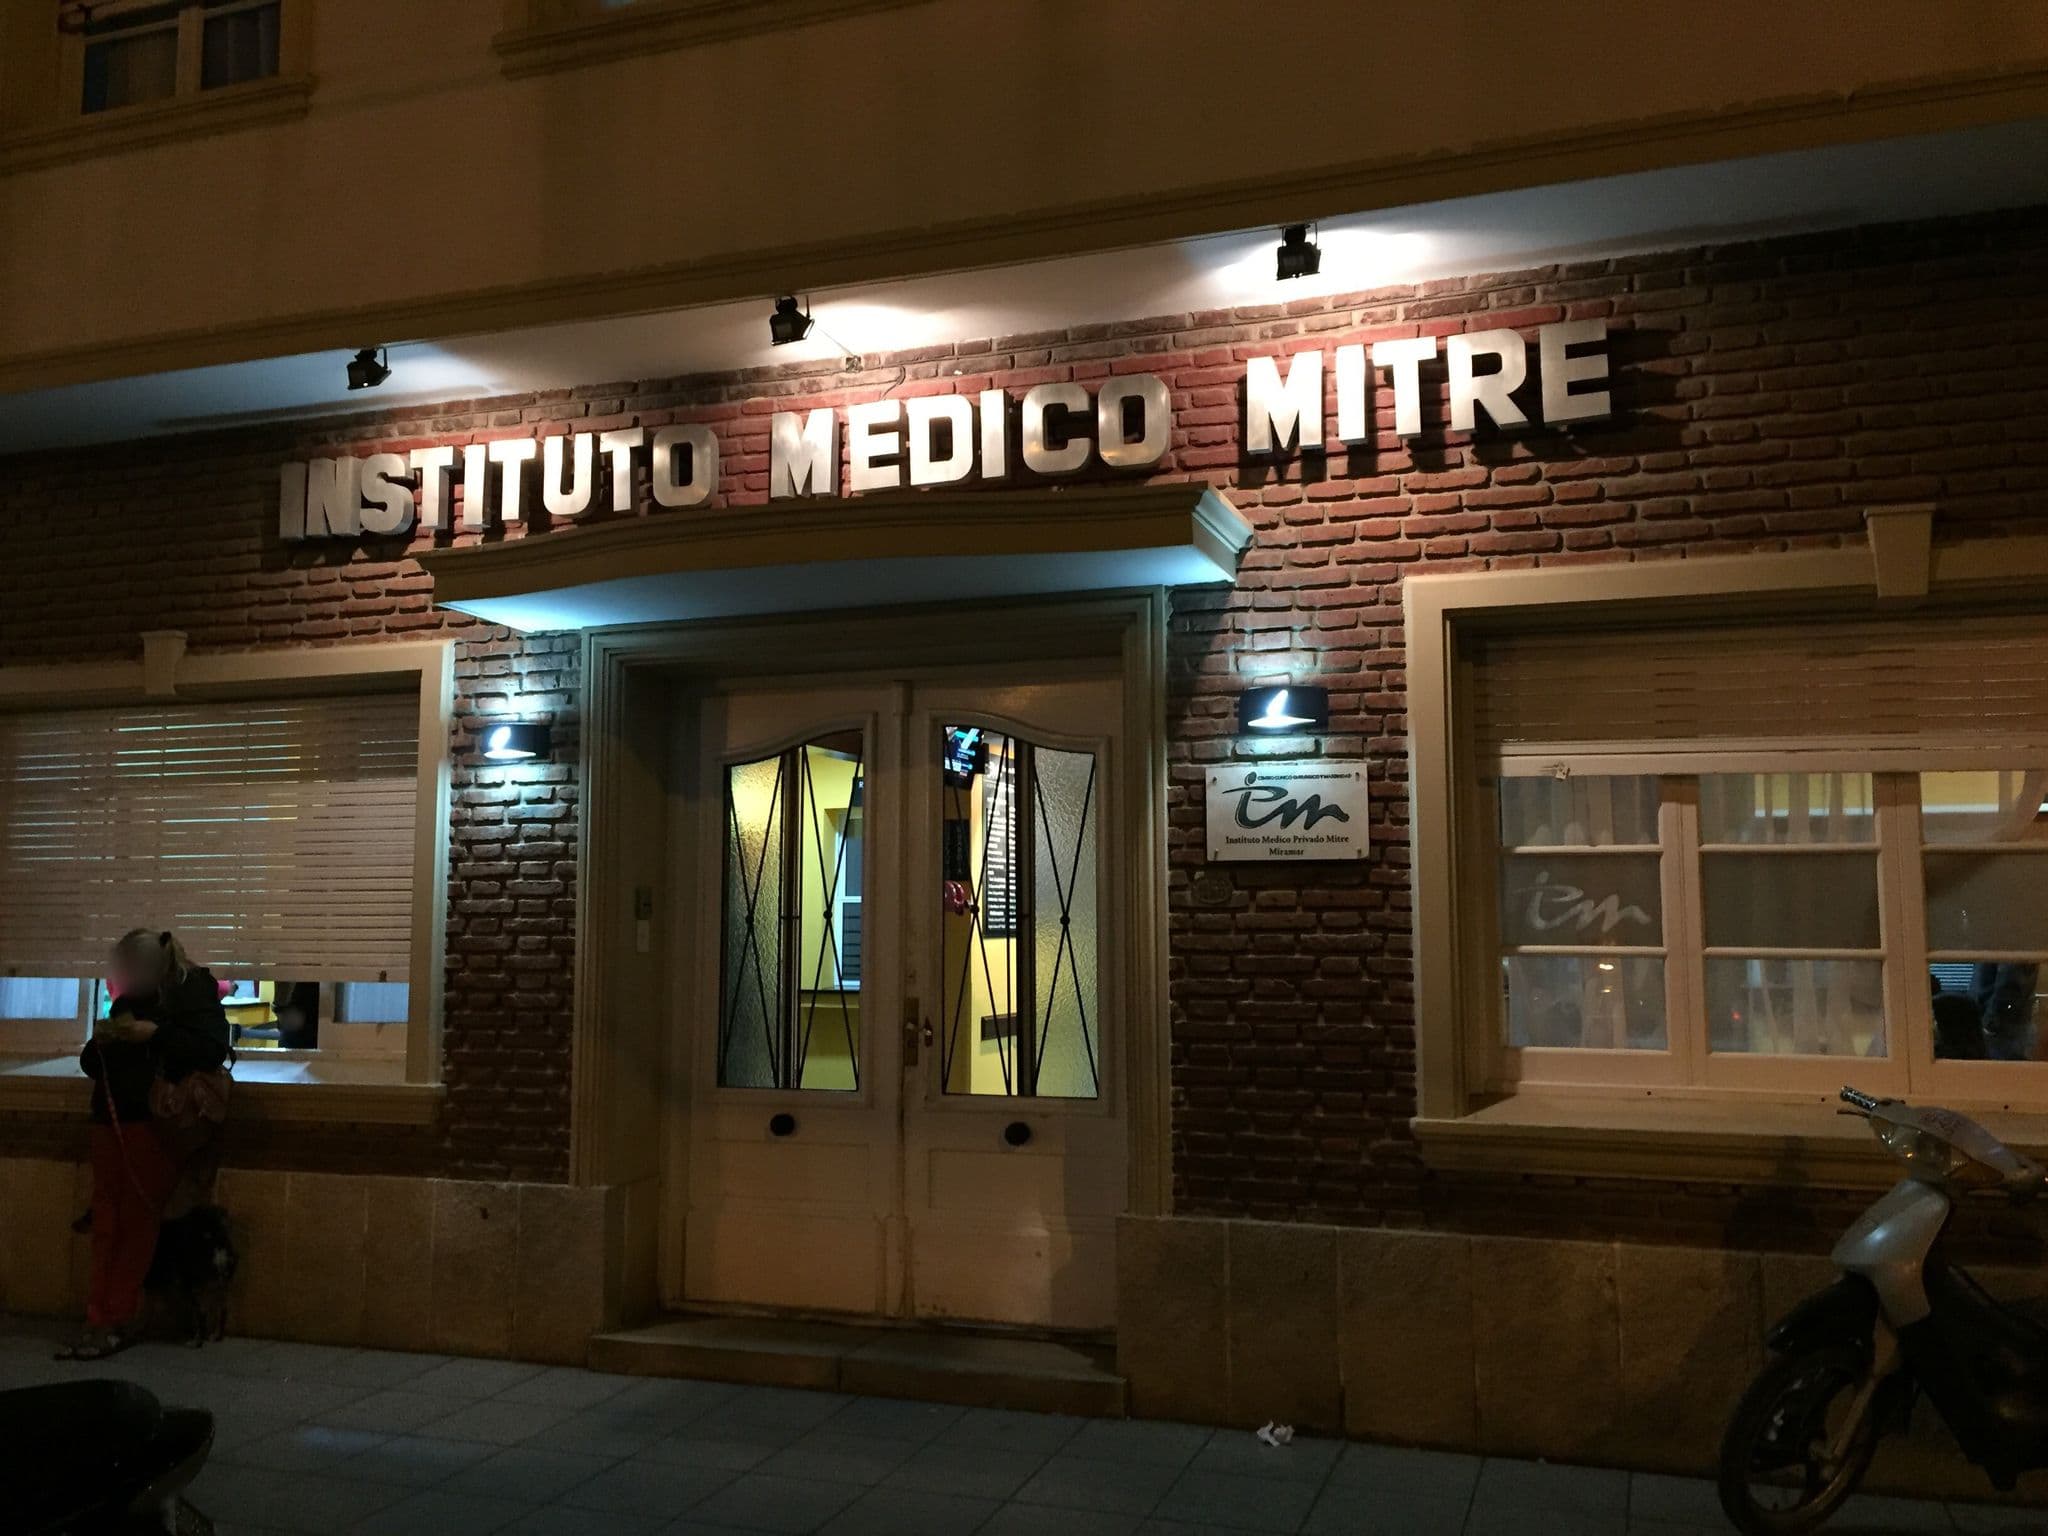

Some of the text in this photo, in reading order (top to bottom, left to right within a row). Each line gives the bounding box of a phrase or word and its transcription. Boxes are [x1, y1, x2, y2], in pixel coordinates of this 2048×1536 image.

[279, 319, 1612, 538] INSTITUTO MEDICO MITRE
[1226, 834, 1350, 844] Instituto Medico Privado Mitre
